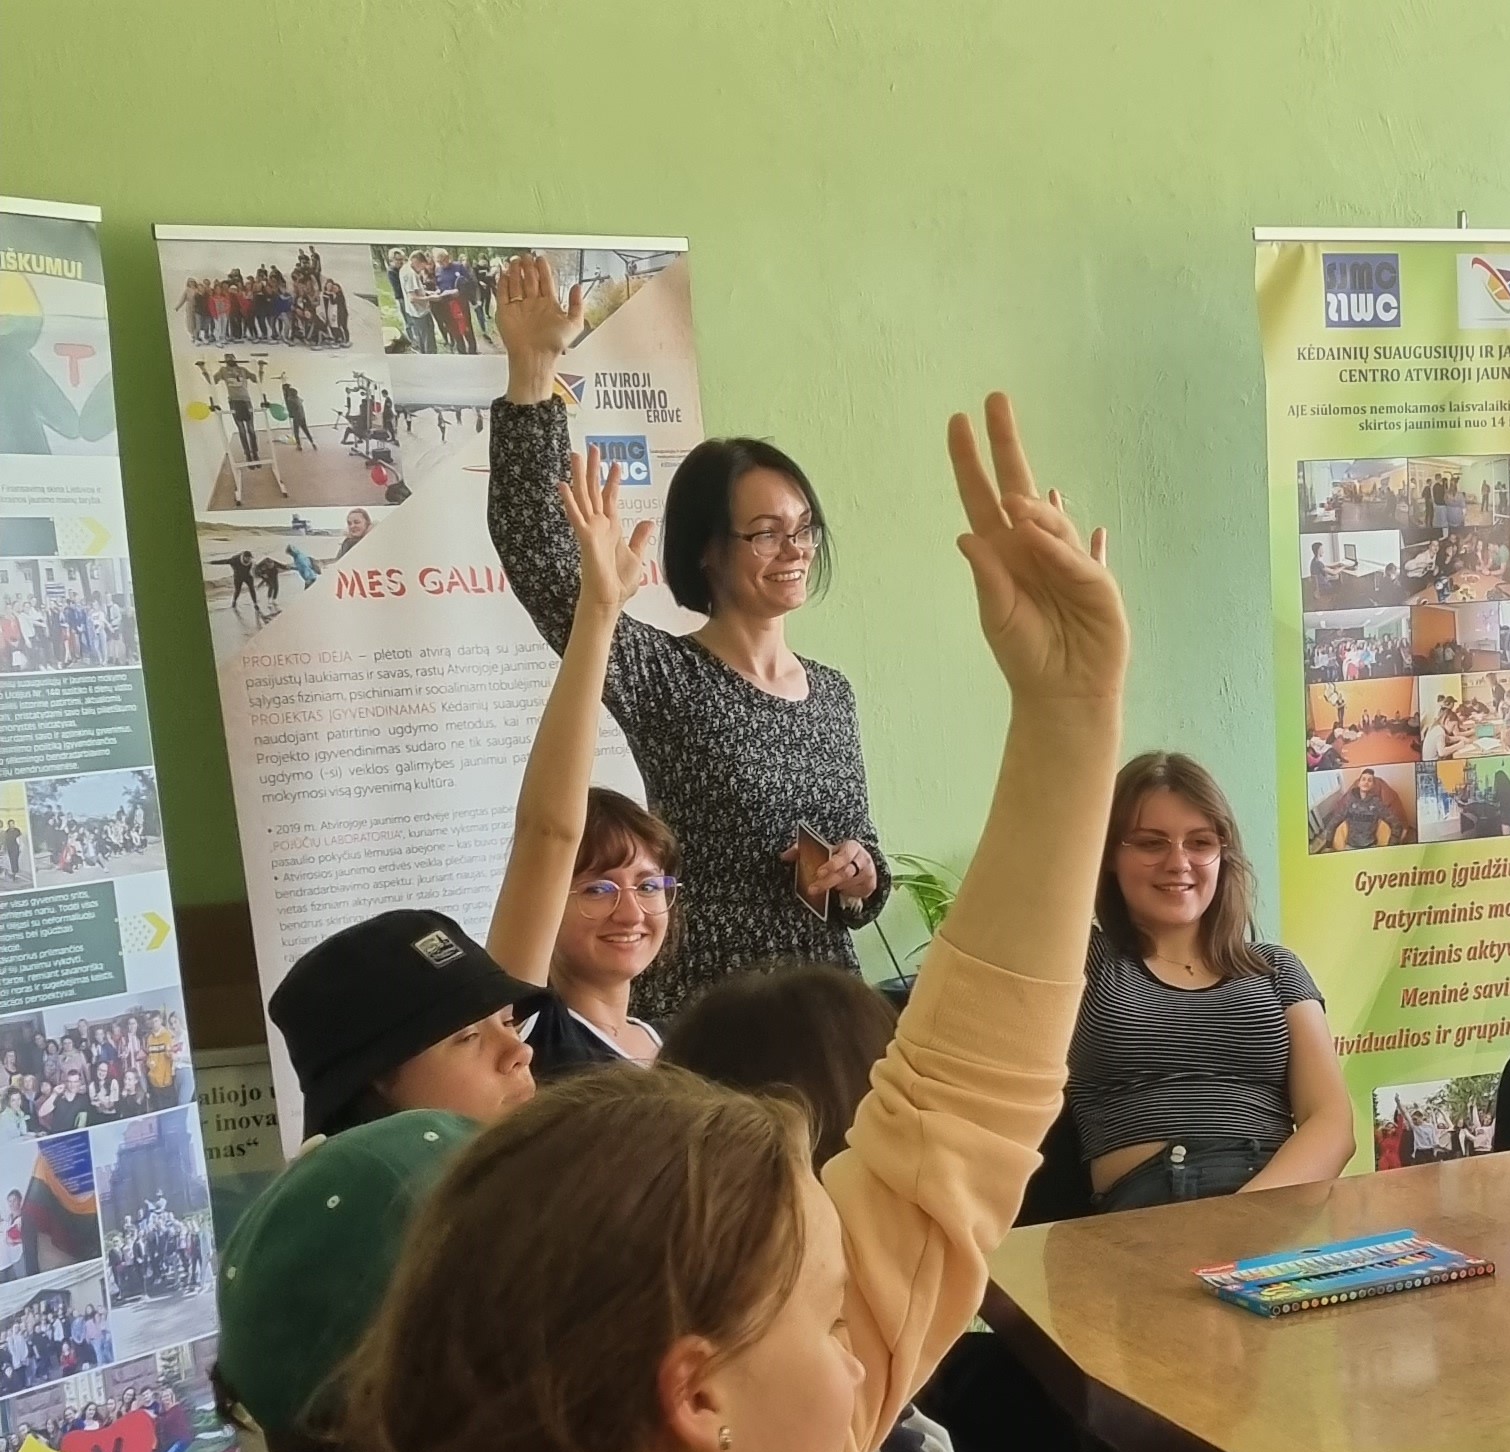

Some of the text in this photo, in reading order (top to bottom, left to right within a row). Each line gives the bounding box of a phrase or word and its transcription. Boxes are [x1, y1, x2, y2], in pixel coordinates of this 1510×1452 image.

[1297, 344, 1369, 363] KĖDAINIŲ
[1374, 345, 1475, 362] SUAUGUSIŲJŲ
[1480, 345, 1494, 358] IR
[595, 373, 651, 388] ATVIROJI
[1339, 368, 1400, 383] CENTRO
[1404, 367, 1471, 383] ATVIROJI
[595, 389, 668, 409] JAUNIMO
[646, 408, 682, 423] ERDVĖ
[1287, 404, 1307, 418] AJE
[1310, 403, 1367, 416] siūlomos
[1370, 402, 1445, 414] nemokamos
[1358, 418, 1401, 431] skirtos
[1404, 416, 1461, 432] jaunimui
[1465, 418, 1487, 428] nuo
[1491, 417, 1505, 427] 14
[336, 567, 406, 599] MES
[243, 653, 311, 668] PROJEKTO
[496, 645, 508, 654] su
[305, 671, 363, 684] laukiamas
[367, 671, 374, 681] ir
[501, 660, 547, 675] jaunimo
[350, 687, 412, 702] psichiniam
[416, 685, 423, 695] ir
[426, 681, 486, 695] socialiniam
[251, 710, 323, 726] PROJEKTAS
[254, 731, 319, 745] naudojant
[389, 722, 438, 737] ugdymo
[504, 716, 519, 727] kai
[257, 750, 309, 766] Projekto
[406, 740, 446, 753] sudaro
[451, 739, 464, 749] ne
[469, 737, 480, 747] tik
[487, 735, 531, 749] saugaus
[259, 769, 313, 786] ugdymo
[349, 763, 389, 776] veiklos
[262, 787, 327, 804] mokymosi
[276, 822, 300, 835] 2019
[370, 813, 411, 828] jaunimo
[1355, 866, 1447, 896] Gyvenimo
[1373, 901, 1484, 933] Patyriminis
[1400, 943, 1462, 968] Fizinis
[1401, 982, 1468, 1008] Meninė
[1435, 1024, 1451, 1044] ir
